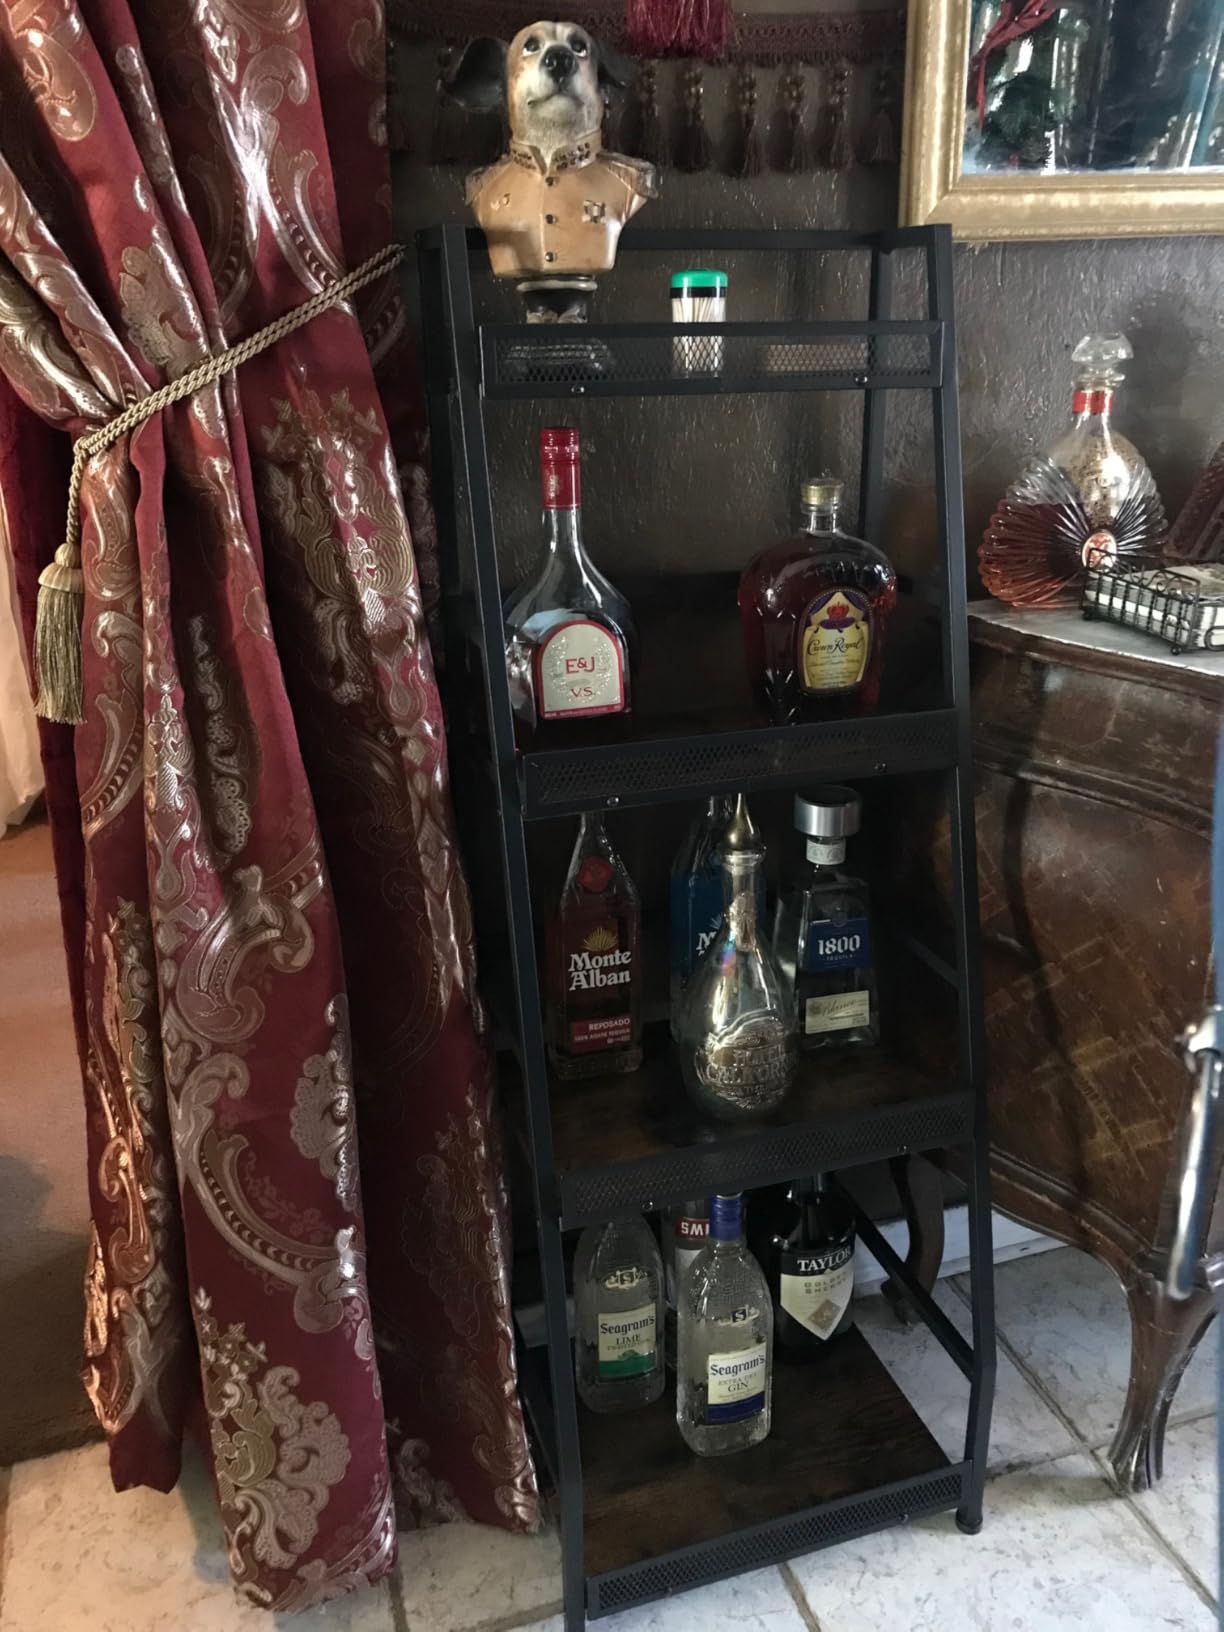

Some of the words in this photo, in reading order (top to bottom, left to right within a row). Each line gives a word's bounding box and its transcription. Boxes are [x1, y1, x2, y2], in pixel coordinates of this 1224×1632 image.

[565, 656, 595, 674] E&J
[817, 934, 860, 955] 1800
[568, 949, 631, 972] Monte
[569, 969, 631, 991] Alban
[588, 1018, 631, 1031] REPOSADO
[600, 1315, 655, 1336] Seagram's
[616, 1334, 640, 1345] LIME
[710, 1354, 765, 1377] Seagram's
[728, 1381, 749, 1392] GIN
